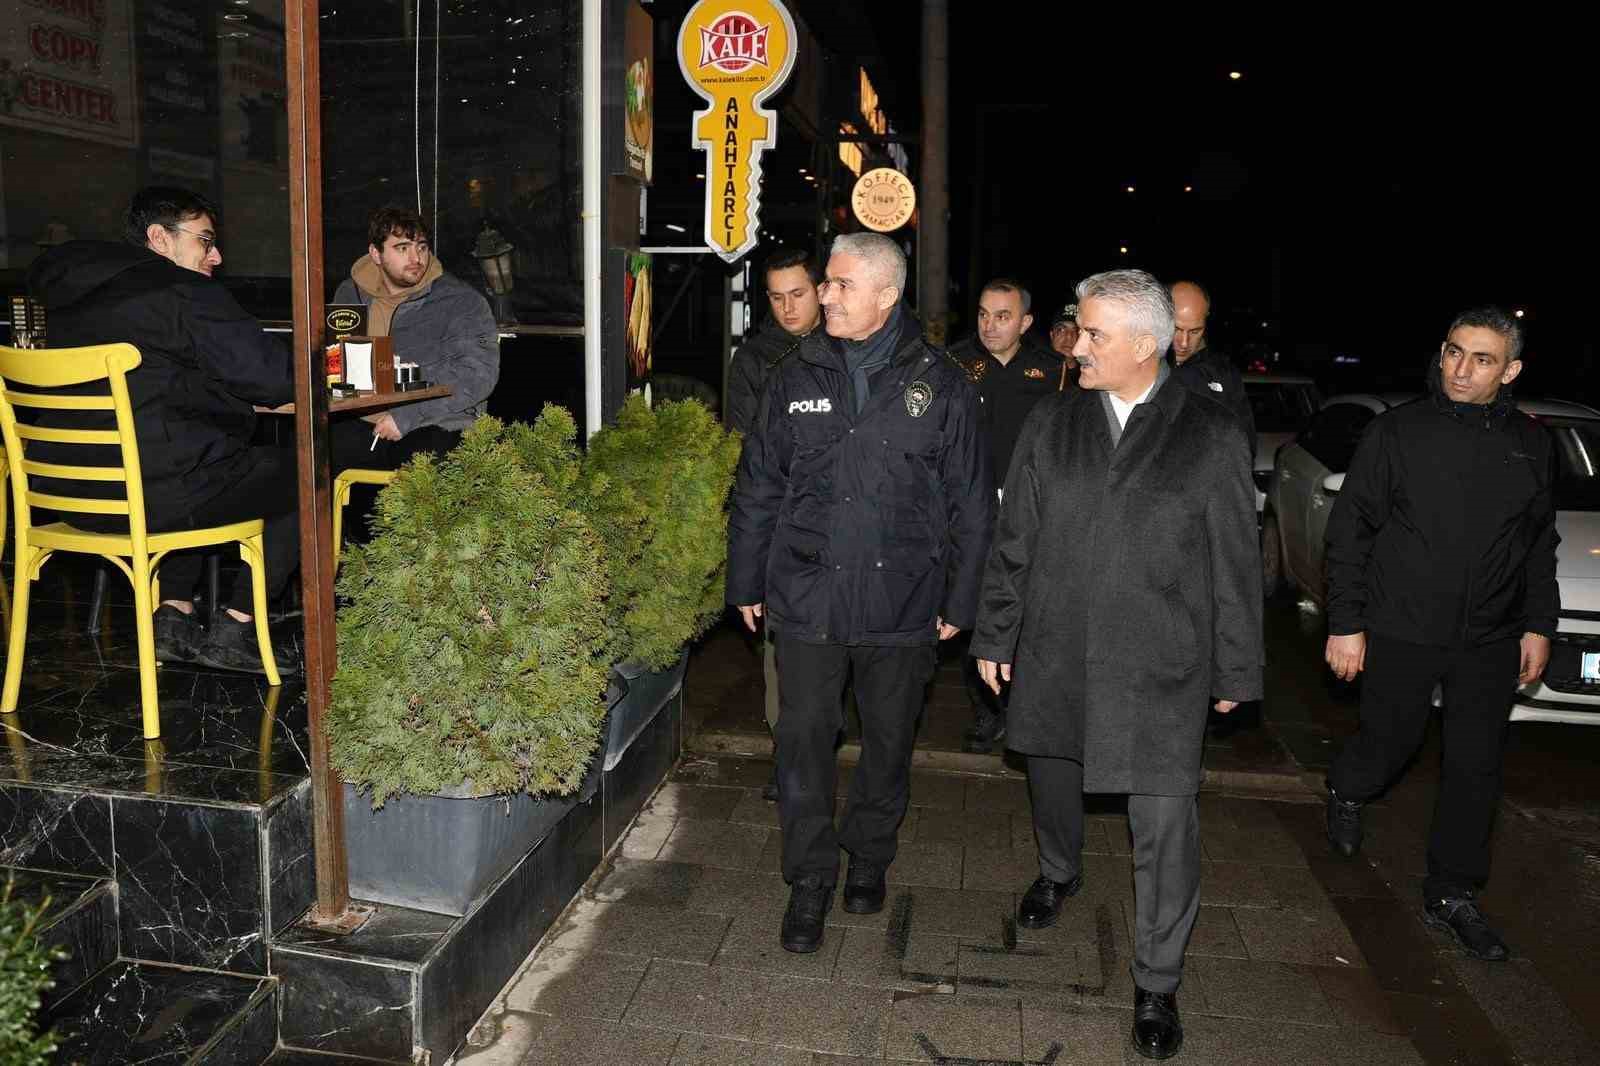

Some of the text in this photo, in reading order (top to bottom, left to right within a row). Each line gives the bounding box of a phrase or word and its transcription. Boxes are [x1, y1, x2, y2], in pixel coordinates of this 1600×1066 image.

[30, 25, 99, 66] COPY
[702, 28, 766, 63] KALE
[22, 74, 115, 122] CENTER
[723, 97, 739, 246] ANAHTARCI
[788, 398, 832, 414] POLIS
